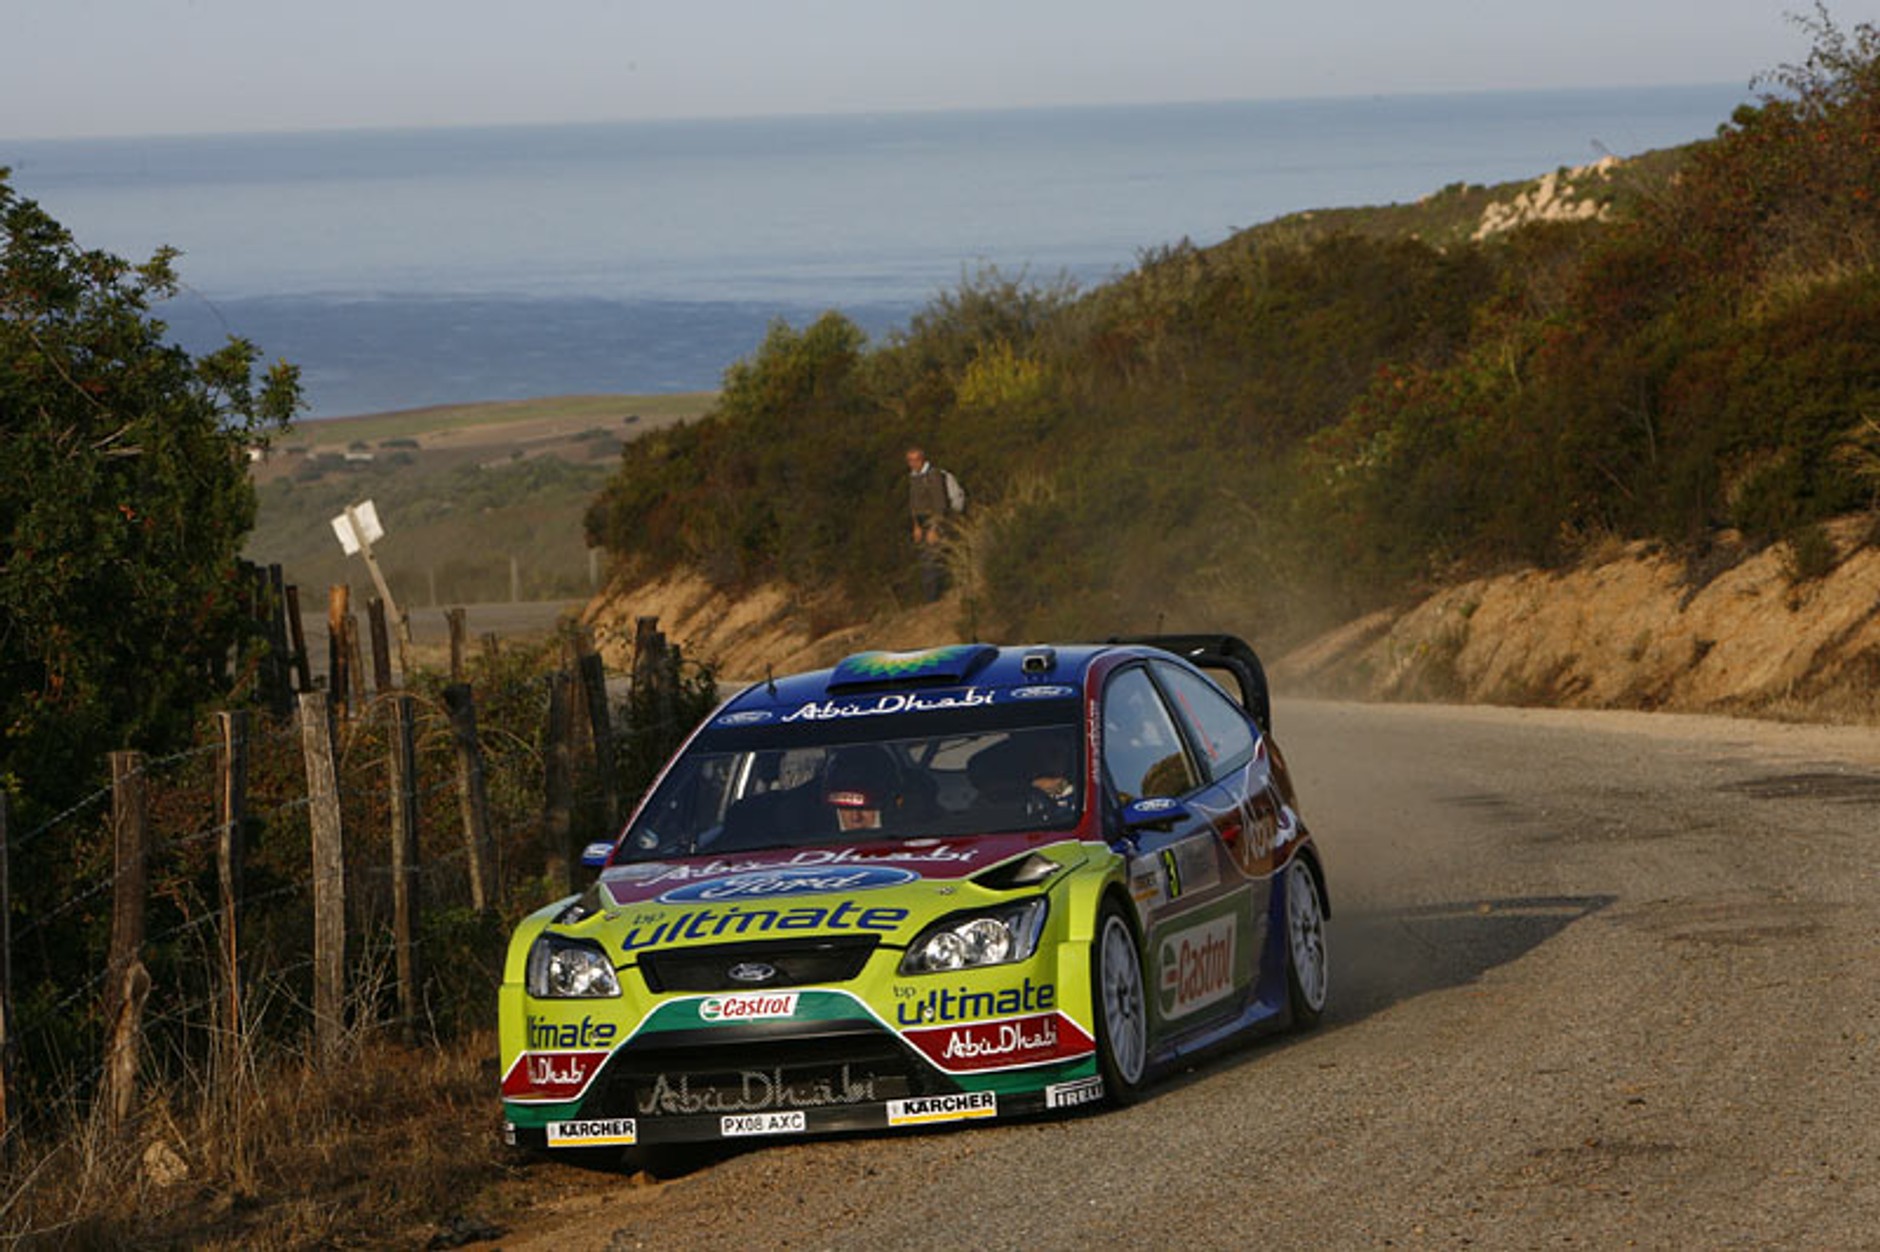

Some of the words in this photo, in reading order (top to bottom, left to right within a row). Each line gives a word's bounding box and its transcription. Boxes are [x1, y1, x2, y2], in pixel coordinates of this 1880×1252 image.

[781, 701, 872, 723] Abu
[868, 687, 996, 714] Dhabi
[701, 872, 871, 899] Ford
[621, 901, 909, 951] ultimate
[1179, 924, 1233, 1005] Castrol
[723, 996, 792, 1017] Castrol
[897, 977, 1056, 1025] ultimate
[942, 1031, 1001, 1058] Abu
[998, 1018, 1058, 1053] Dhabi
[639, 1073, 742, 1115] Abu
[737, 1064, 877, 1110] Dhabi
[769, 1113, 802, 1130] AXC
